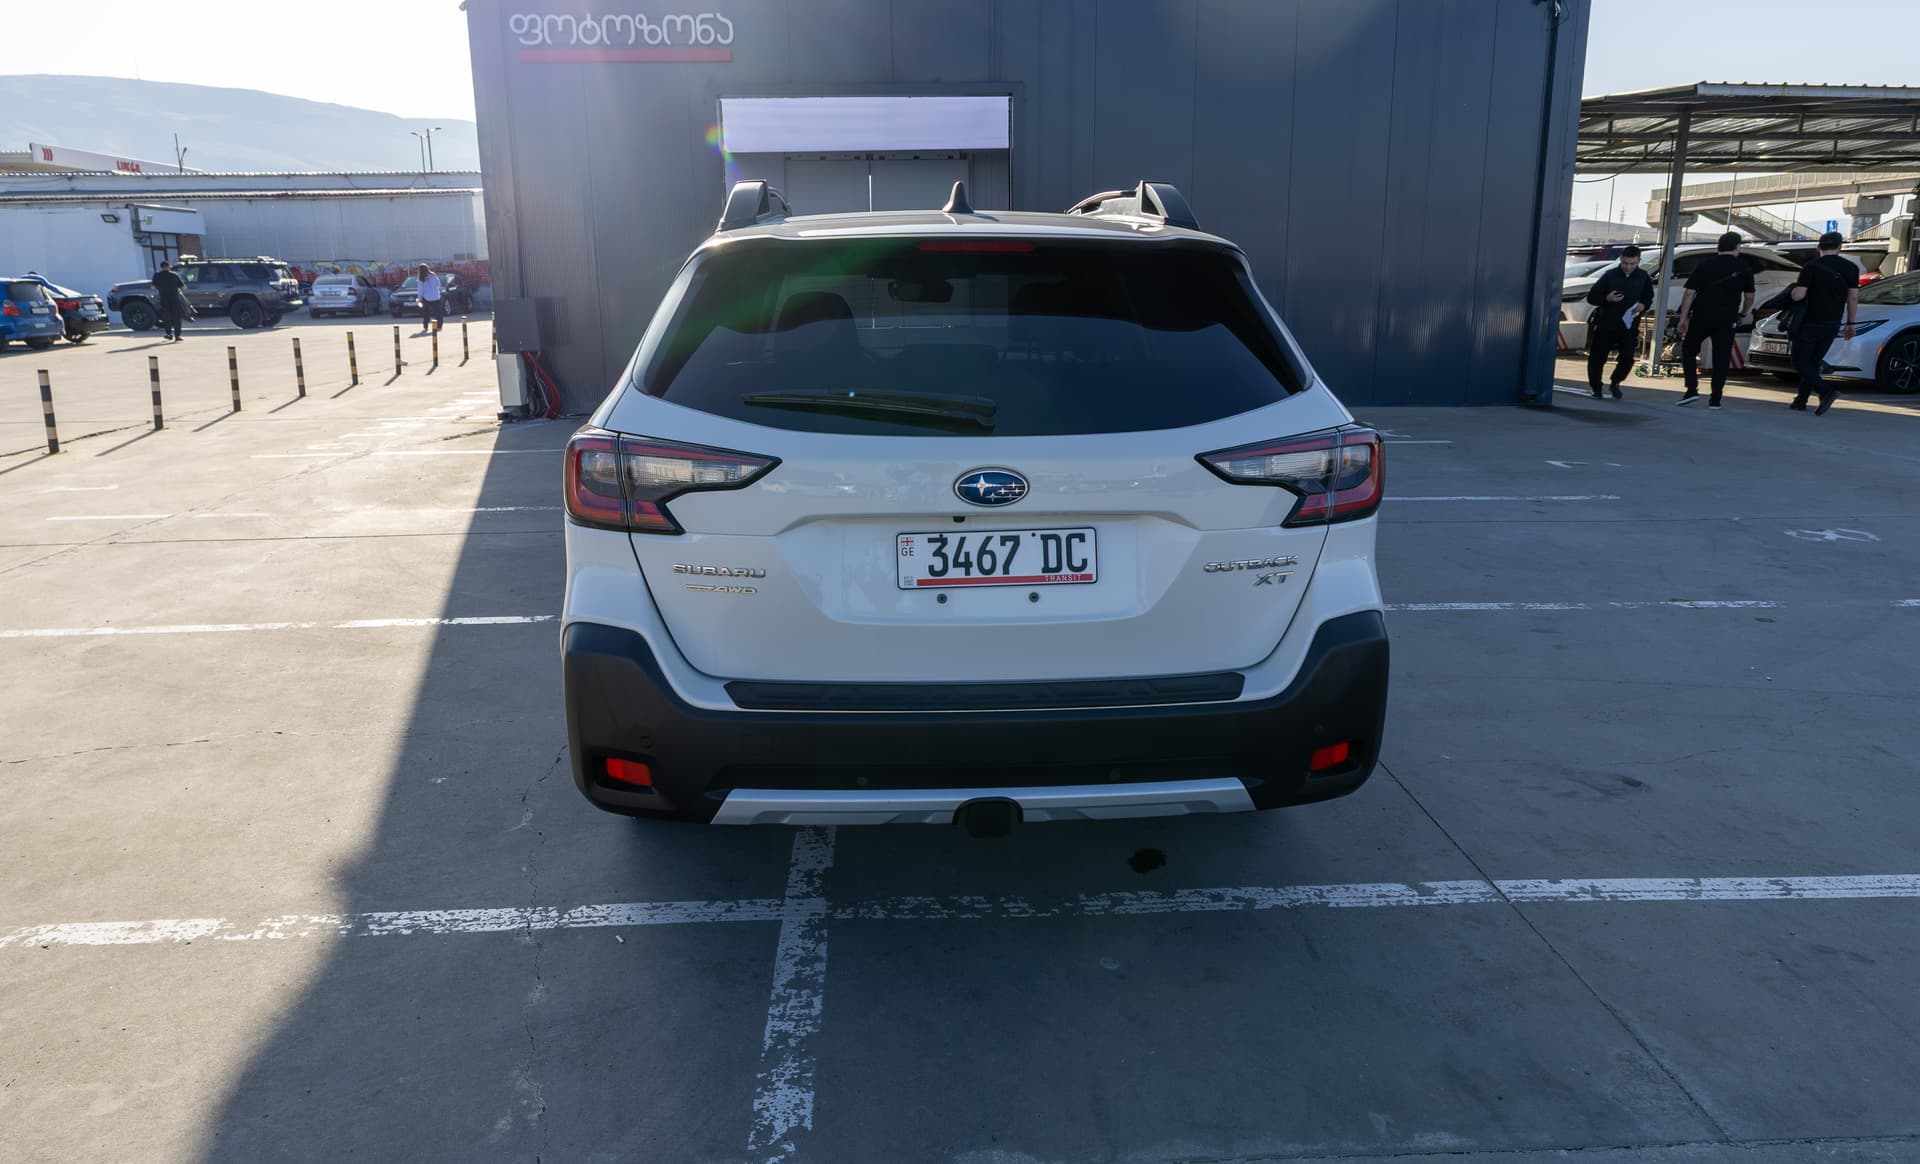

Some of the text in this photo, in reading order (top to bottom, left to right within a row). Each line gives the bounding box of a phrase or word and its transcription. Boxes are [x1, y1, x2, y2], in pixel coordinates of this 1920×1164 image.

[510, 13, 734, 45] ფოტოზონა
[901, 547, 915, 557] GE
[927, 533, 1088, 577] 3467 DC
[672, 563, 766, 578] SUBARU
[1204, 555, 1299, 573] OUTBACK
[1045, 574, 1082, 582] TRANSIT
[1253, 571, 1294, 585] XT
